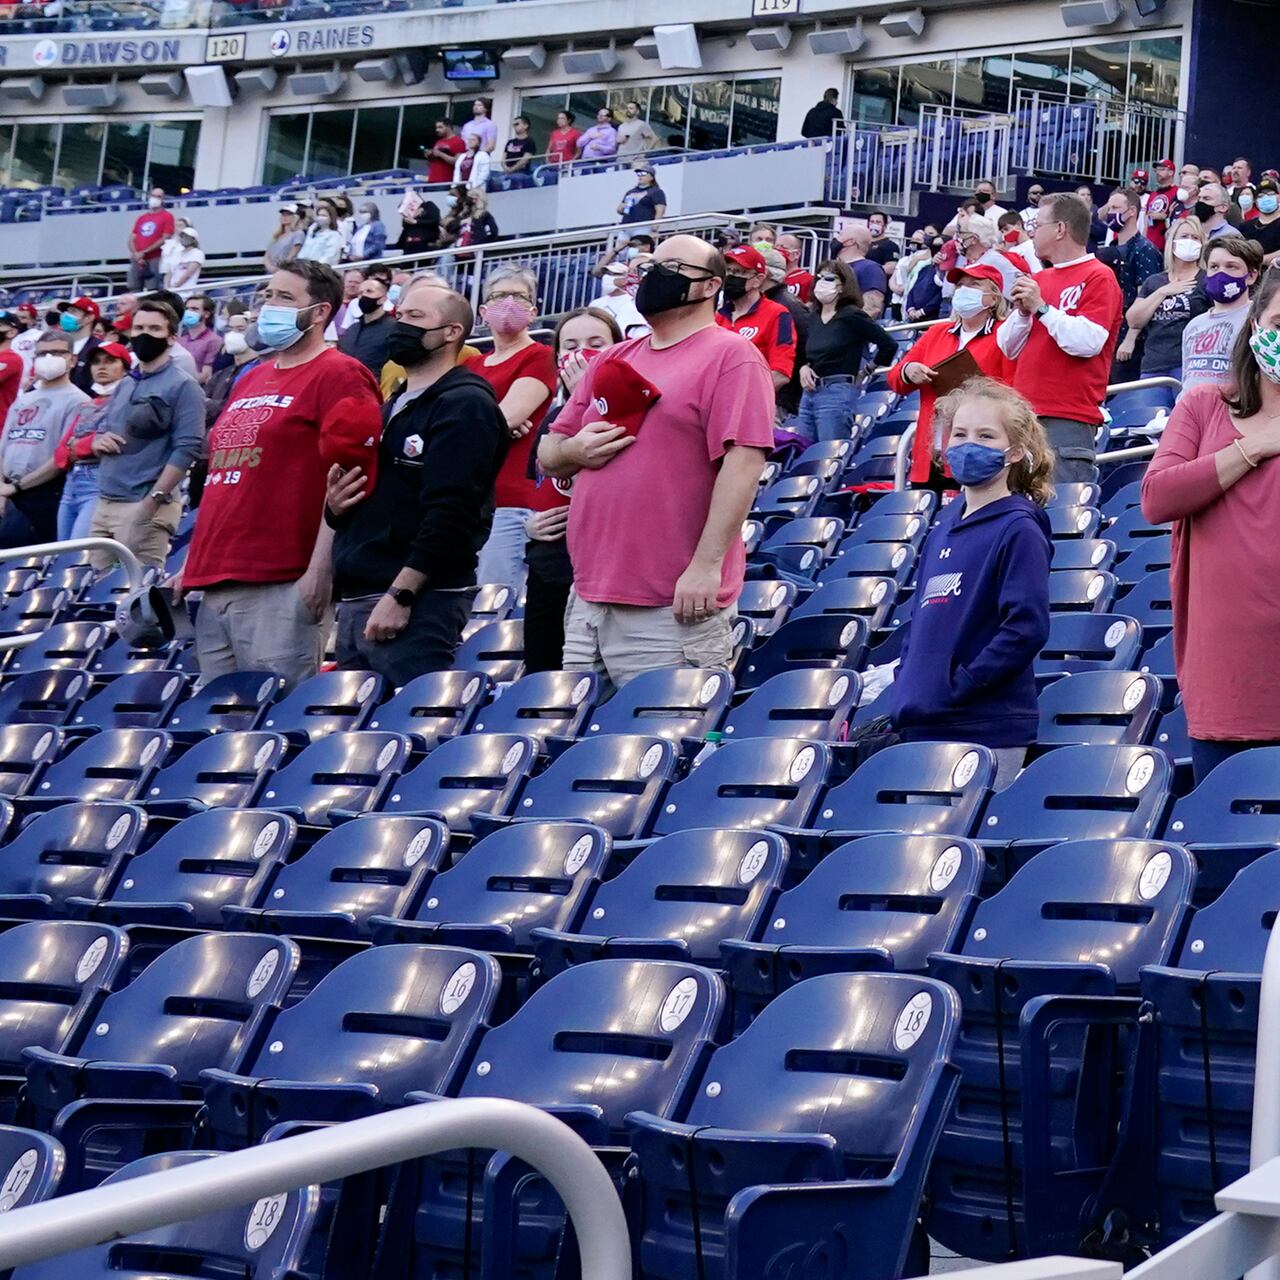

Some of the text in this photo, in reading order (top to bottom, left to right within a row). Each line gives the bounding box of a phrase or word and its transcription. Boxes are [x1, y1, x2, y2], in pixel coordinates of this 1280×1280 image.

[297, 25, 375, 50] RAINES
[61, 40, 181, 64] DAWSON
[211, 39, 239, 57] 120
[1134, 765, 1148, 779] 15
[573, 846, 588, 862] 14
[747, 854, 762, 868] 15
[938, 862, 954, 878] 16
[1146, 867, 1165, 885] 17
[83, 951, 99, 969] 14
[255, 963, 273, 982] 15
[450, 979, 469, 998] 16
[668, 994, 691, 1014] 17
[903, 1010, 924, 1032] 18
[8, 1169, 29, 1191] 17
[256, 1201, 280, 1227] 18
